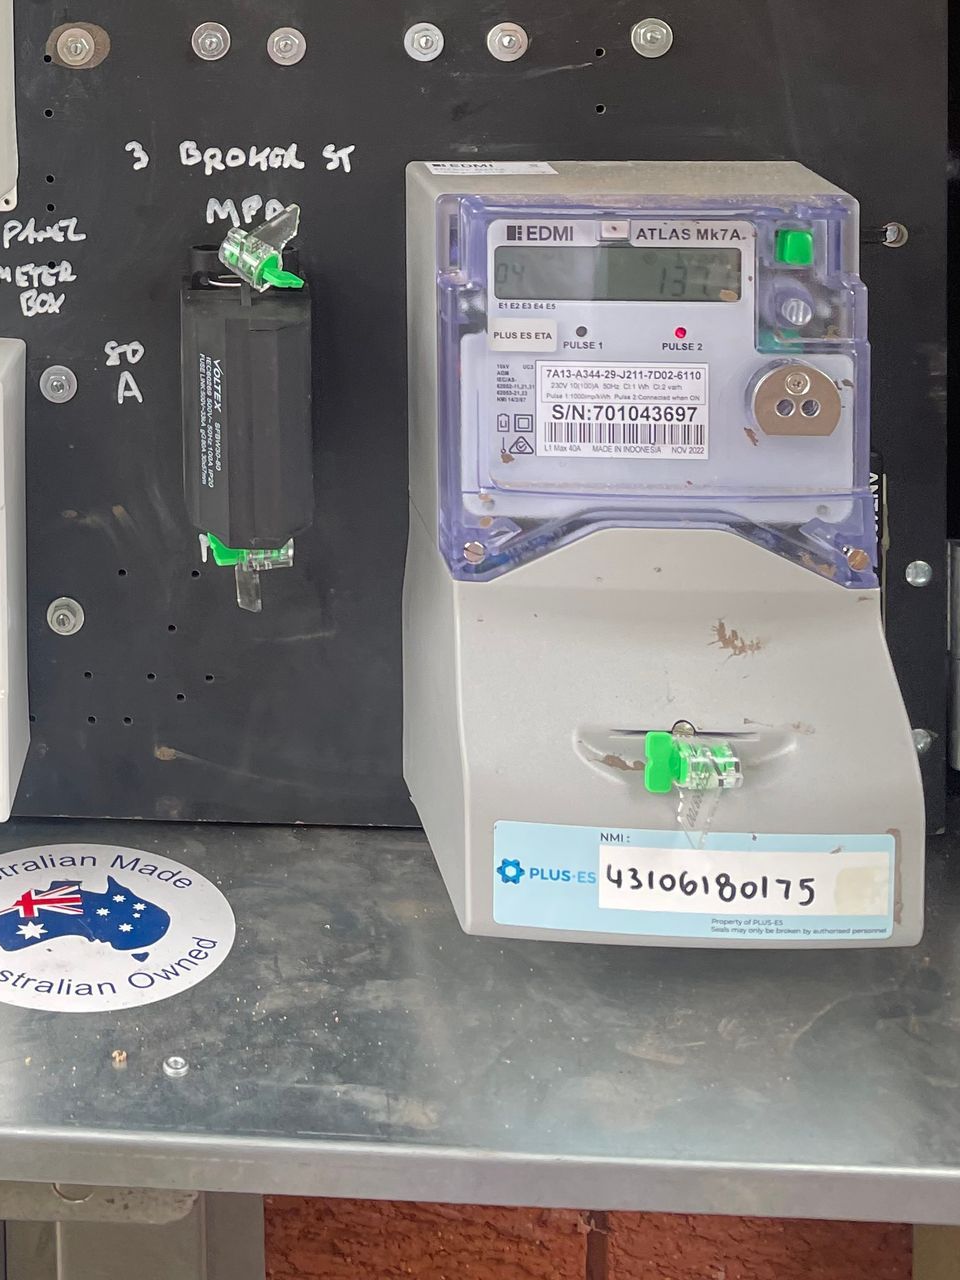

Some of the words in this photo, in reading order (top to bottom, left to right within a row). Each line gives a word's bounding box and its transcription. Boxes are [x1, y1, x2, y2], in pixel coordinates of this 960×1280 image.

[125, 140, 150, 170] 3
[180, 141, 305, 176] BROKER
[322, 144, 356, 174] ST
[206, 194, 285, 228] MPD
[3, 217, 87, 249] PANEL
[526, 225, 574, 241] EDMI
[636, 228, 691, 240] ATLAS
[696, 228, 741, 240] Mk7A
[19, 288, 65, 317] BOX
[493, 332, 518, 340] PLUS
[520, 332, 532, 340] ES
[534, 332, 552, 340] ETA
[563, 341, 596, 350] PULSE
[598, 341, 603, 350] 1
[662, 342, 695, 351] PULSE
[697, 343, 703, 351] 2
[117, 370, 144, 404] A
[213, 359, 224, 413] VOLTEX
[552, 404, 698, 422] S/N:701043697
[110, 854, 193, 890] Made
[606, 864, 816, 907] 43106180175
[731, 927, 746, 935] may
[748, 926, 763, 935] only
[803, 927, 811, 935] by
[813, 927, 850, 935] authorised
[852, 927, 887, 935] personnel
[128, 936, 218, 990] Owned
